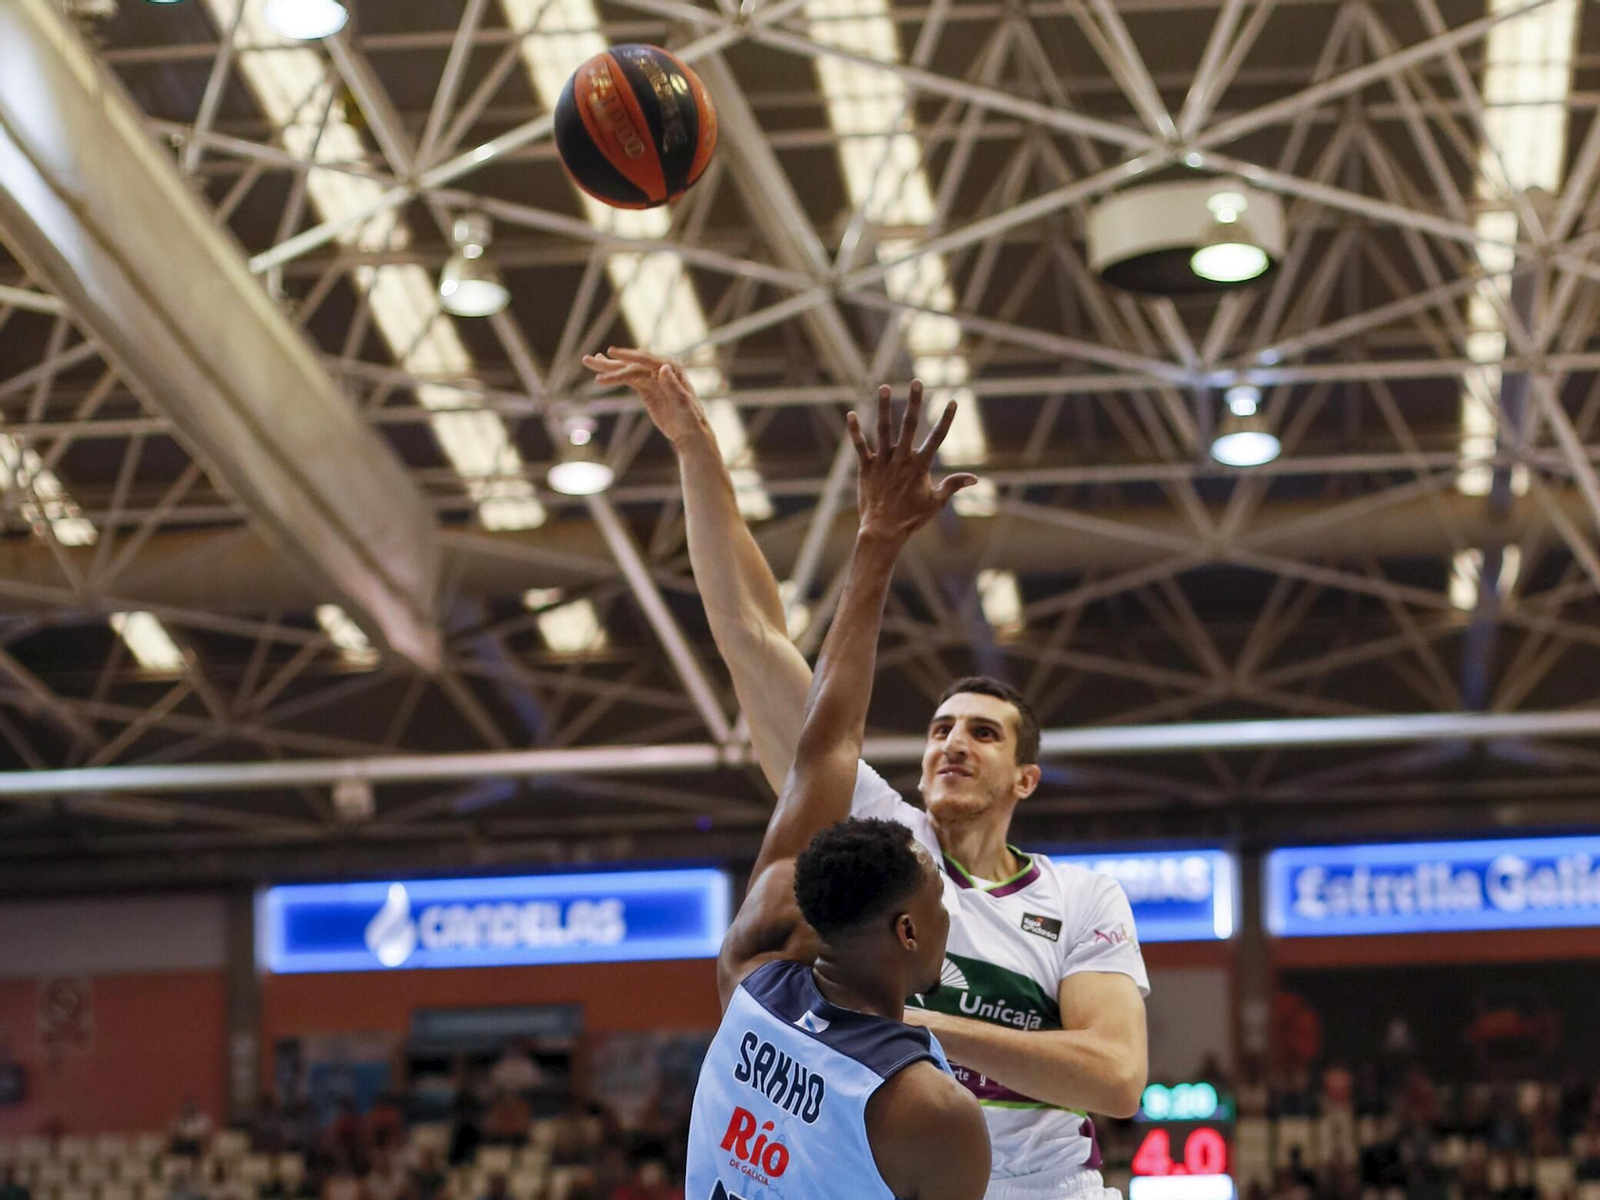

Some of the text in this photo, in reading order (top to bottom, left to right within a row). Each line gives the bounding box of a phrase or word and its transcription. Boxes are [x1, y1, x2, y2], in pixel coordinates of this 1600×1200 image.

[1293, 862, 1482, 919] Estrella
[959, 991, 1042, 1031] Unicaja
[733, 1030, 825, 1126] SAKHO
[719, 1105, 790, 1178] Río
[1132, 1128, 1227, 1175] 4.0
[729, 1158, 769, 1187] DE GALICIA
